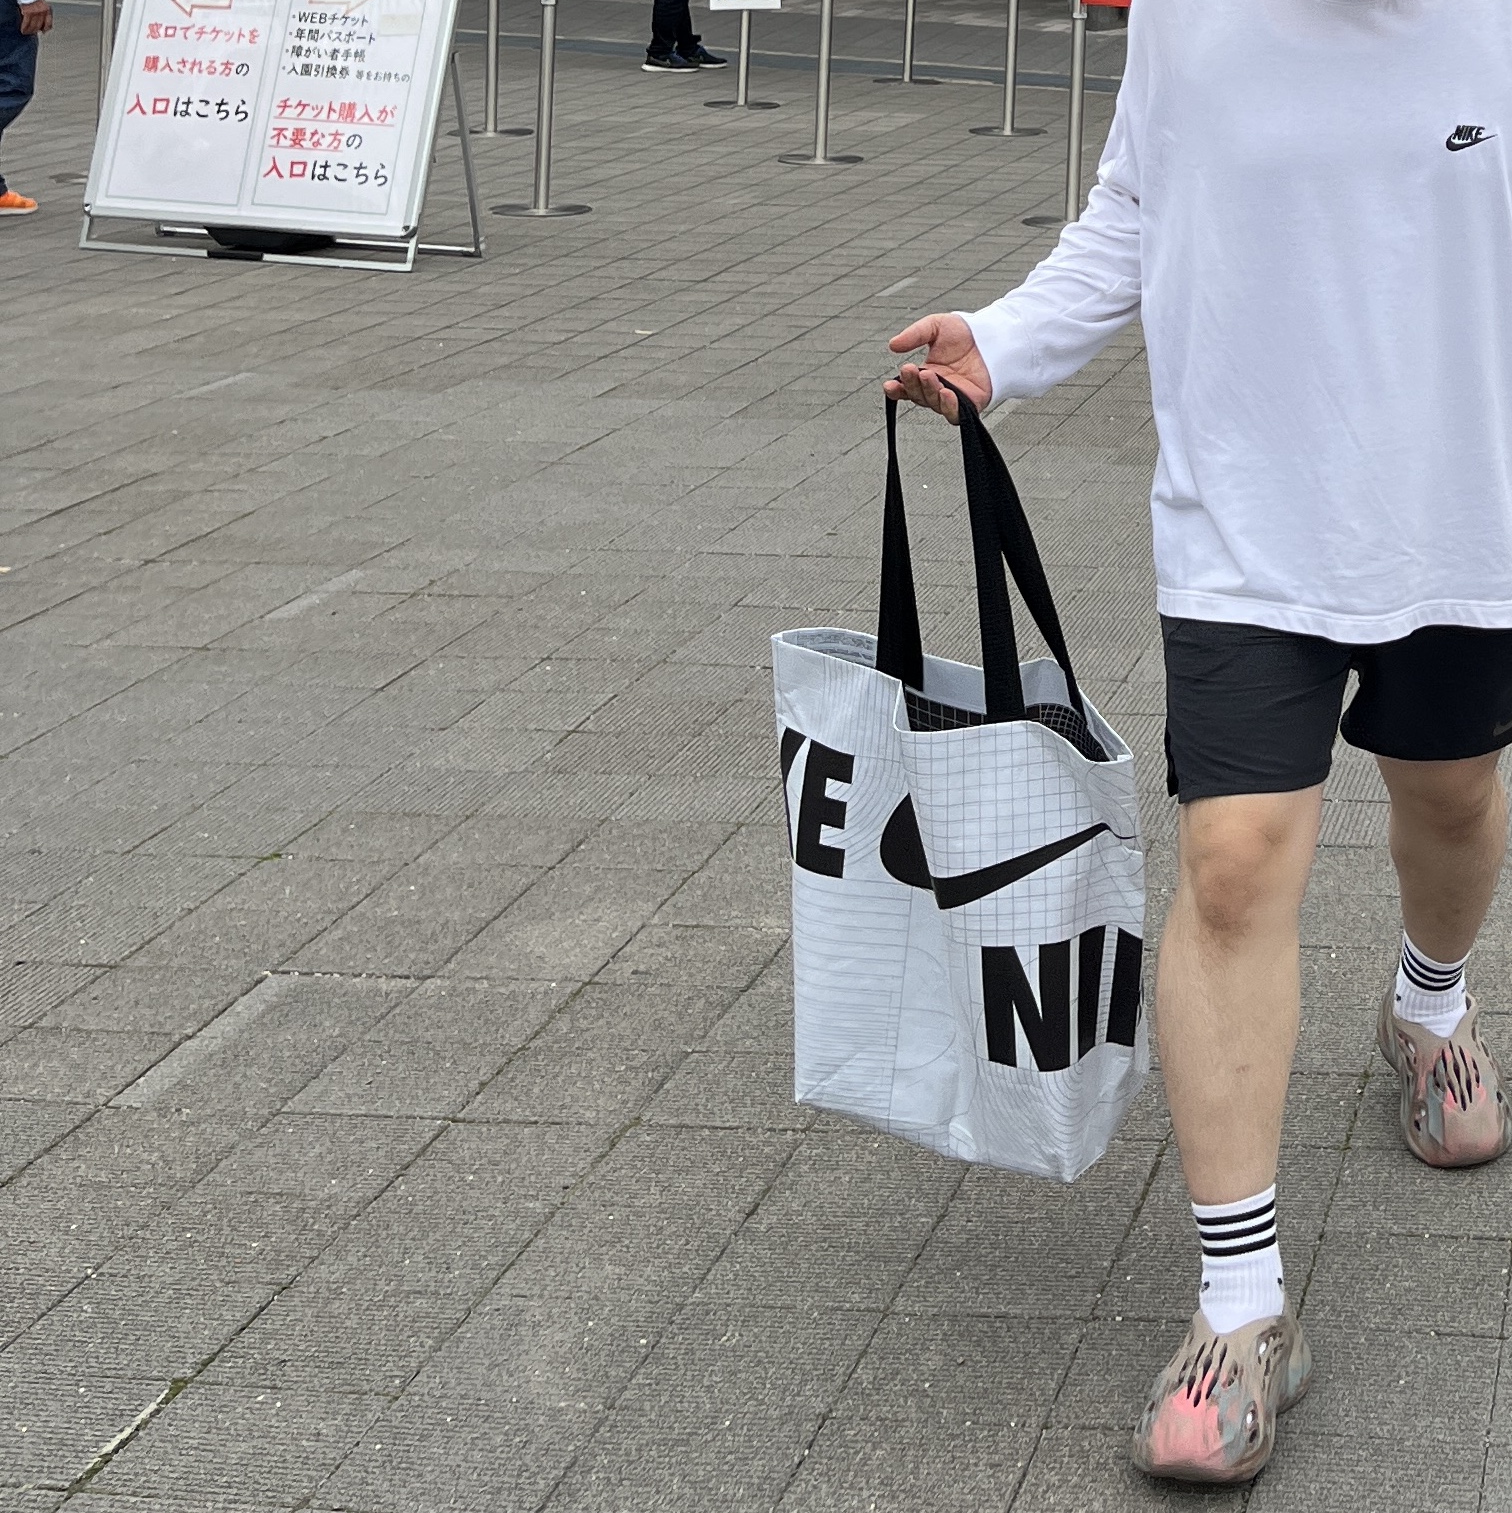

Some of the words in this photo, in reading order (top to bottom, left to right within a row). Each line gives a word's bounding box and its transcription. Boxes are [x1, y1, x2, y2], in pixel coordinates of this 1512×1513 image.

[146, 23, 260, 45] 窓口でチケットを
[143, 55, 250, 78] 購入される方の
[127, 92, 249, 123] 入口はこちら
[276, 95, 398, 123] チケット購入が
[269, 126, 363, 150] 不要な方の
[1454, 124, 1486, 141] NIKE
[262, 155, 389, 187] 入口はこちら
